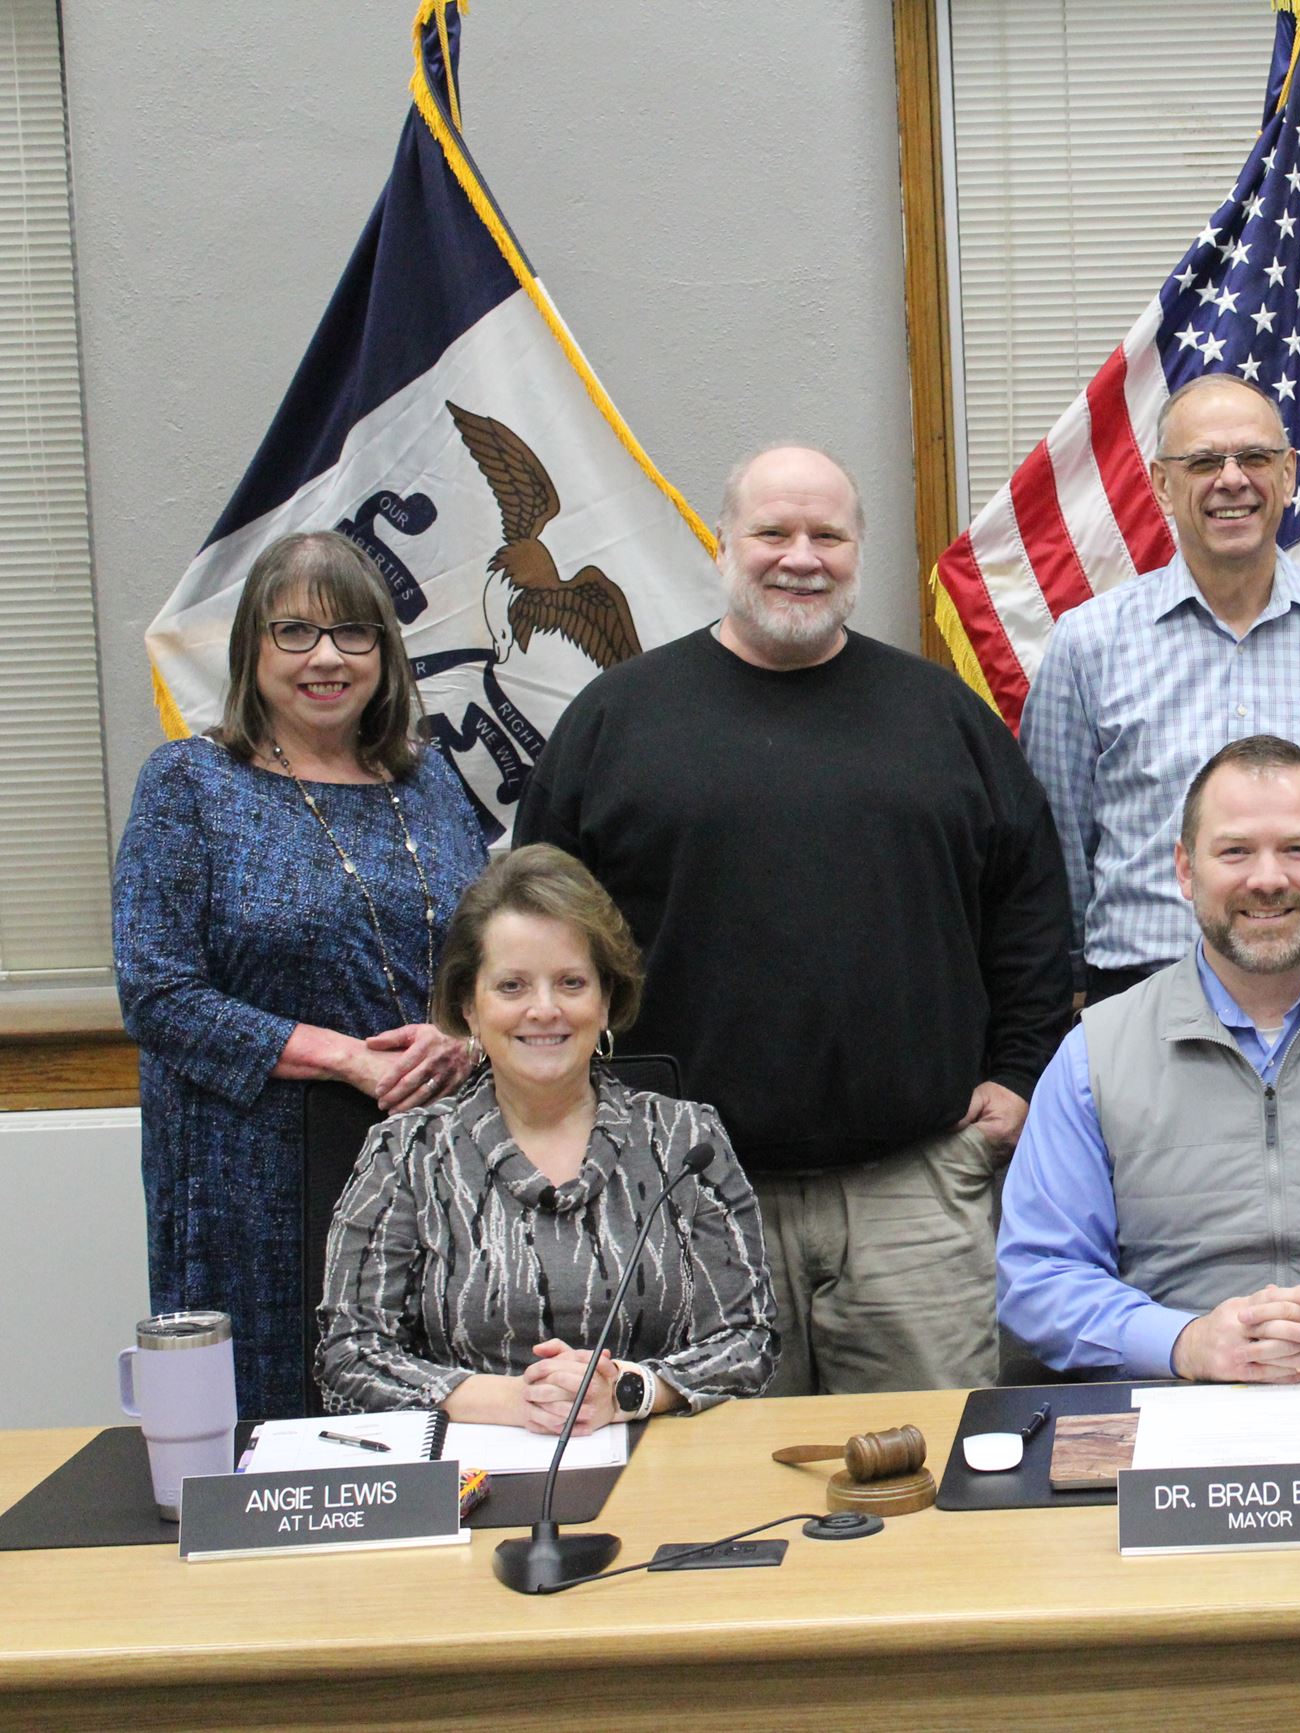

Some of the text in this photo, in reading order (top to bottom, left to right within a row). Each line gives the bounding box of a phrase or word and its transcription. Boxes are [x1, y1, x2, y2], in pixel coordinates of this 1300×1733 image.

[379, 496, 409, 528] OUR
[498, 702, 542, 759] RIGHT
[475, 718, 520, 788] WE WILL
[245, 1480, 397, 1513] ANGIE LEWIS
[1154, 1484, 1197, 1510] DR.
[1208, 1481, 1281, 1508] BRAD
[278, 1511, 365, 1532] AT LARGE
[1228, 1510, 1293, 1529] MAYOR
